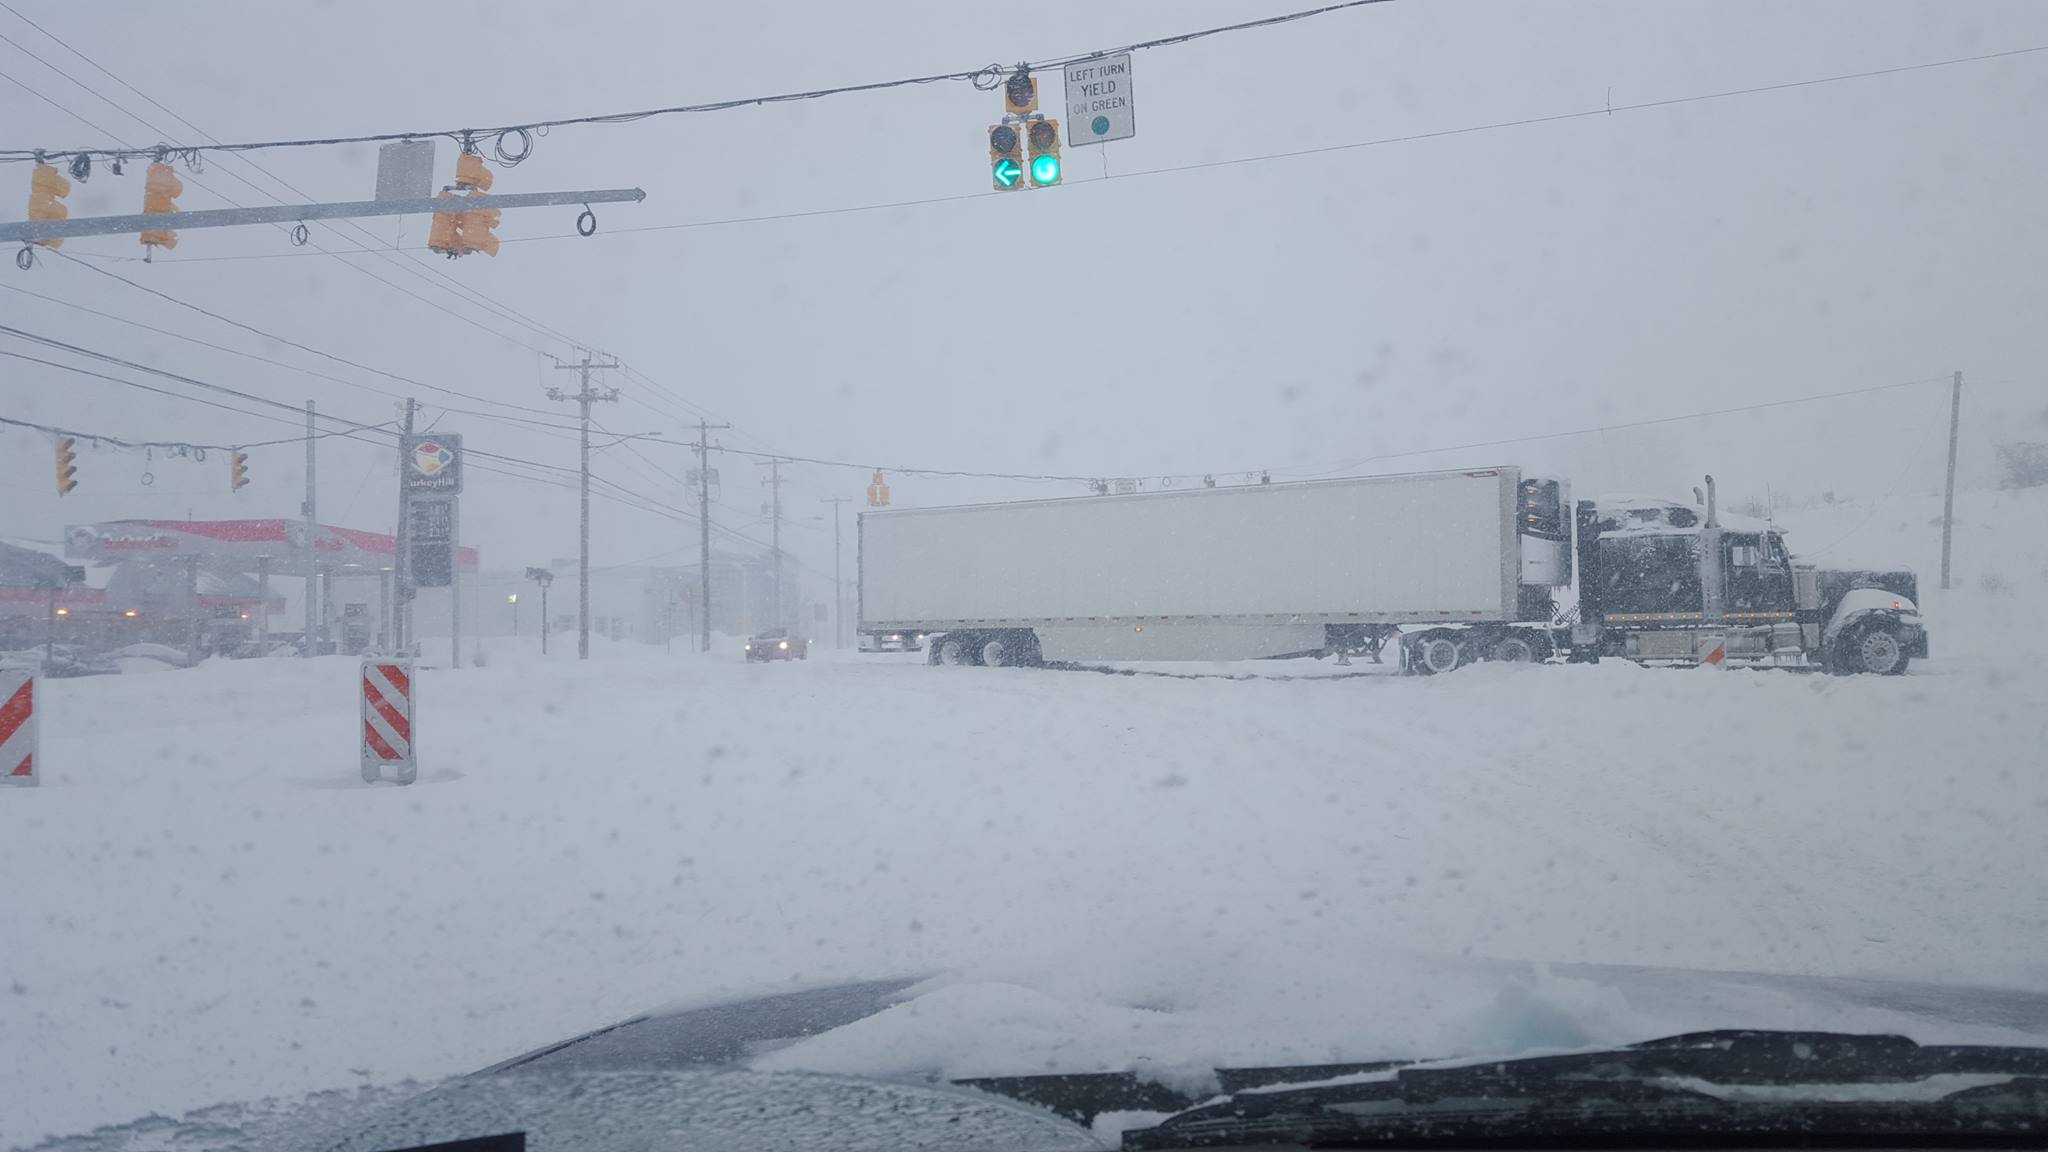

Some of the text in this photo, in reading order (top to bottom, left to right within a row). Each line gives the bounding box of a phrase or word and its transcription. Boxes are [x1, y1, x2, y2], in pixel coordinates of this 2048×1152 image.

[1070, 63, 1125, 82] LEFT TURN
[1081, 80, 1116, 97] YIELD
[1073, 96, 1126, 115] ON GREEN
